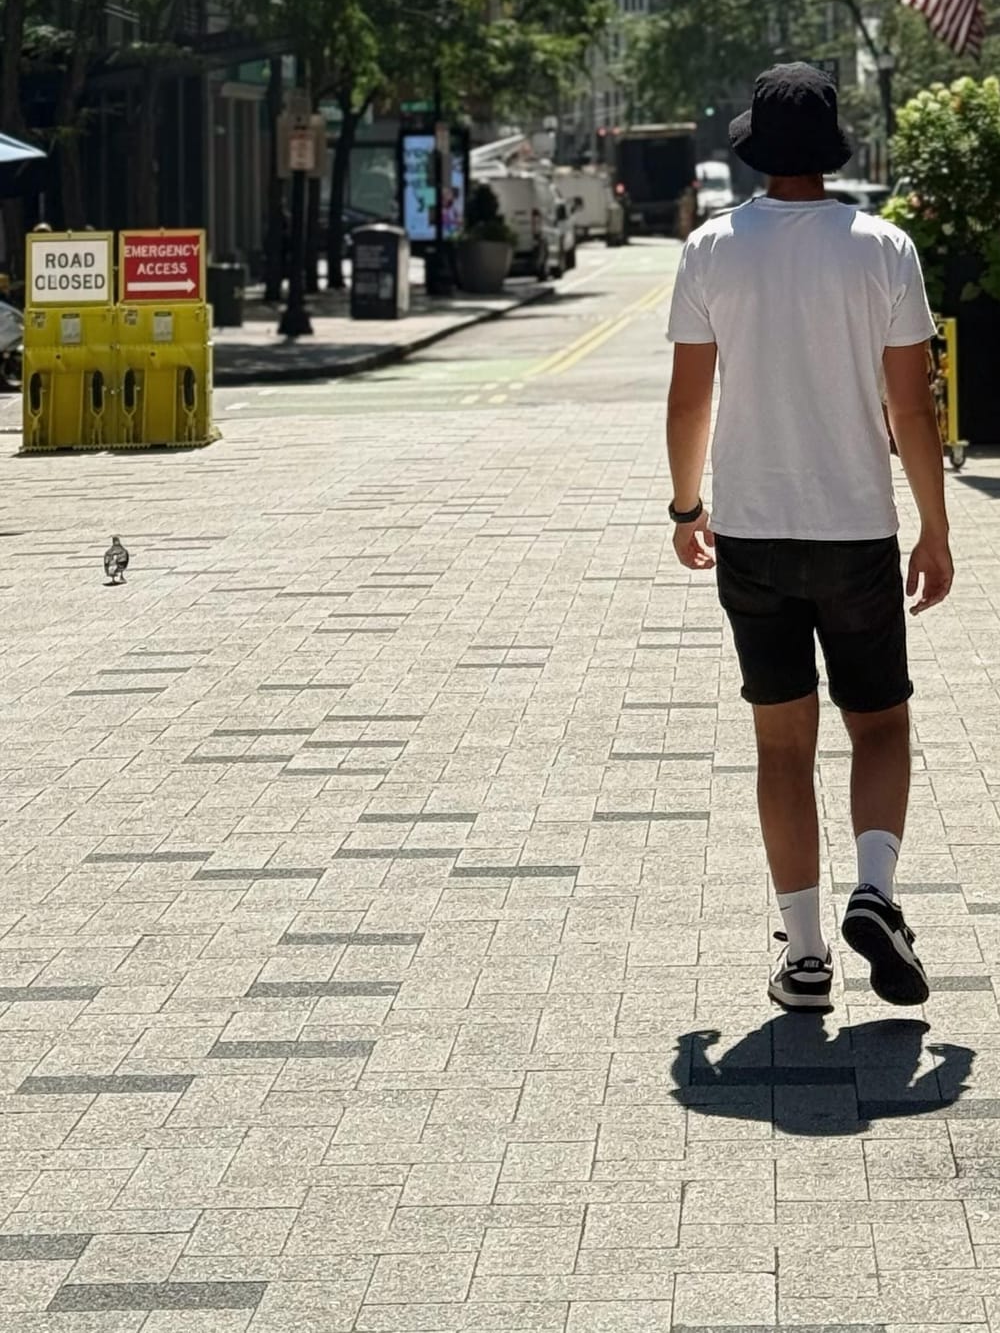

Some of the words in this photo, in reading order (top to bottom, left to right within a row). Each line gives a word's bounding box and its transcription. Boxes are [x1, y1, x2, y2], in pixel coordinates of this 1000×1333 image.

[125, 244, 200, 258] EMERGENCY
[45, 252, 95, 269] ROAD
[137, 262, 188, 275] ACCESS
[35, 274, 105, 290] CLOSED
